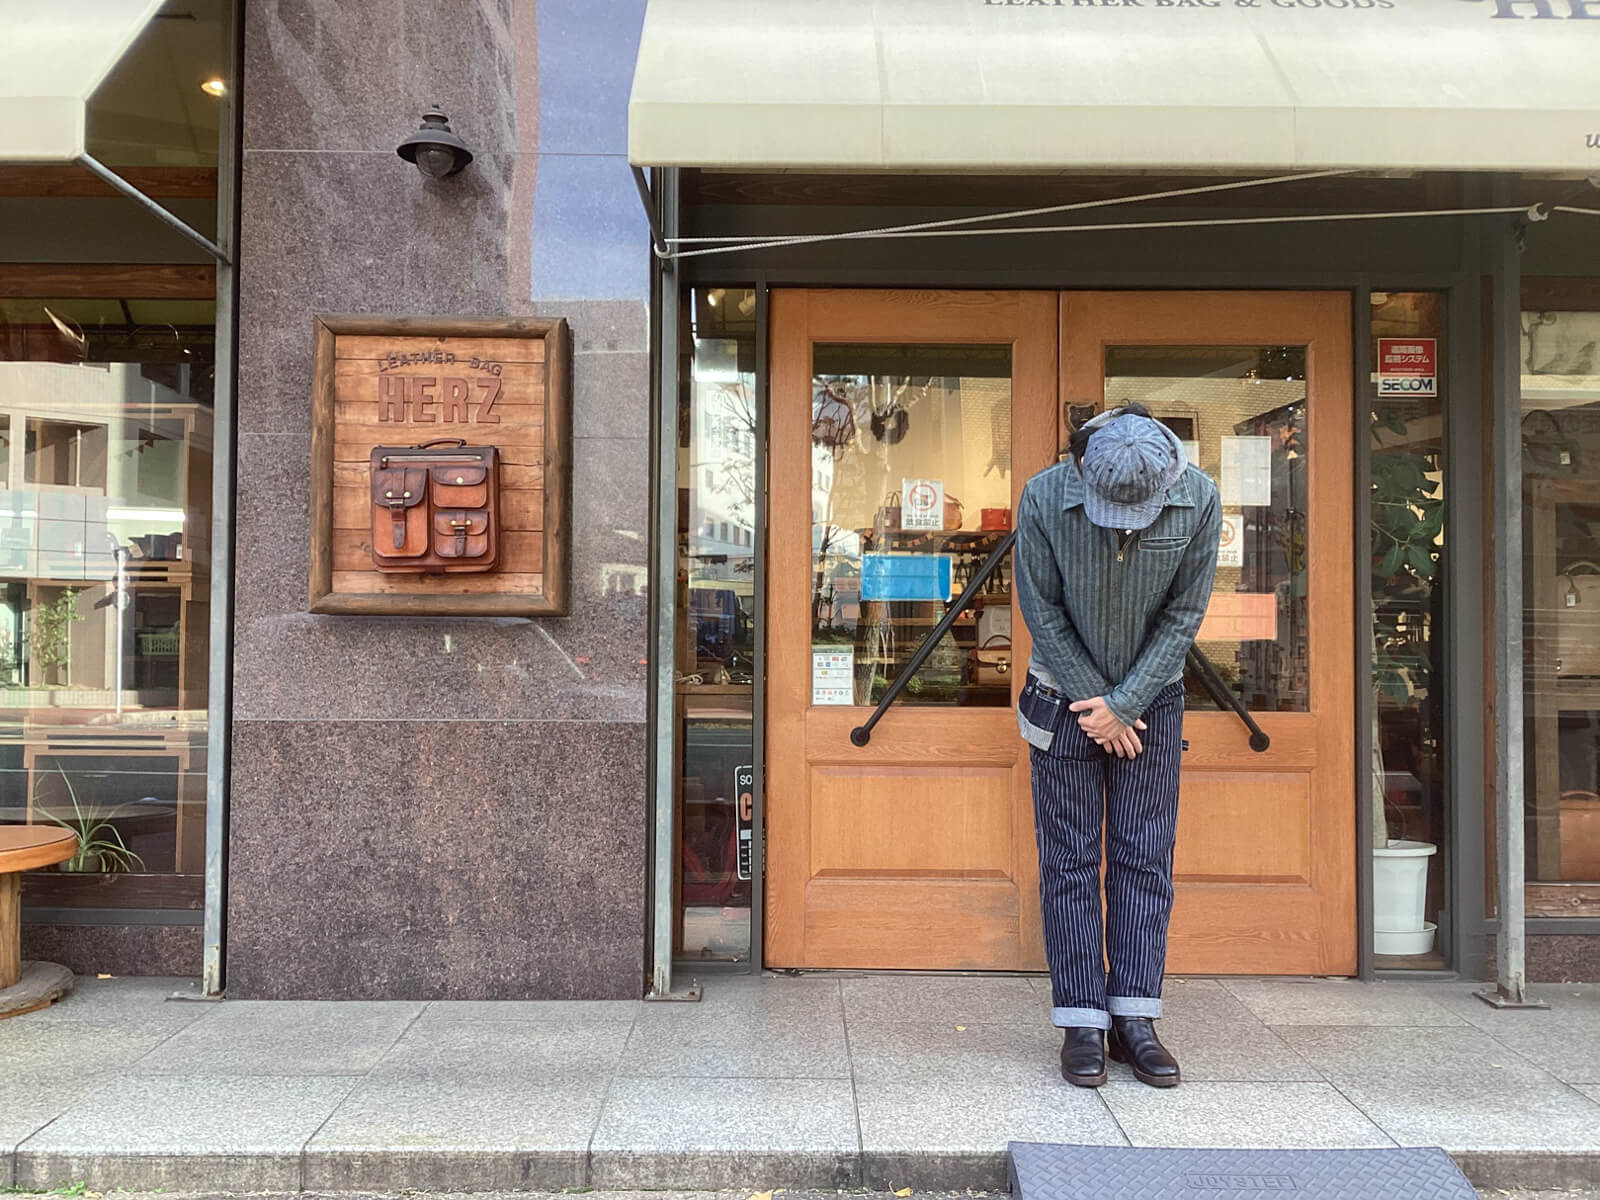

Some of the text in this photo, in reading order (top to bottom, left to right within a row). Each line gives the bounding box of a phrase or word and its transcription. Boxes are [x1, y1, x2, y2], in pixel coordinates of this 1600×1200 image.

[377, 350, 503, 377] LEATHER BAG
[1382, 378, 1433, 391] SECOM
[378, 377, 502, 424] HERZ
